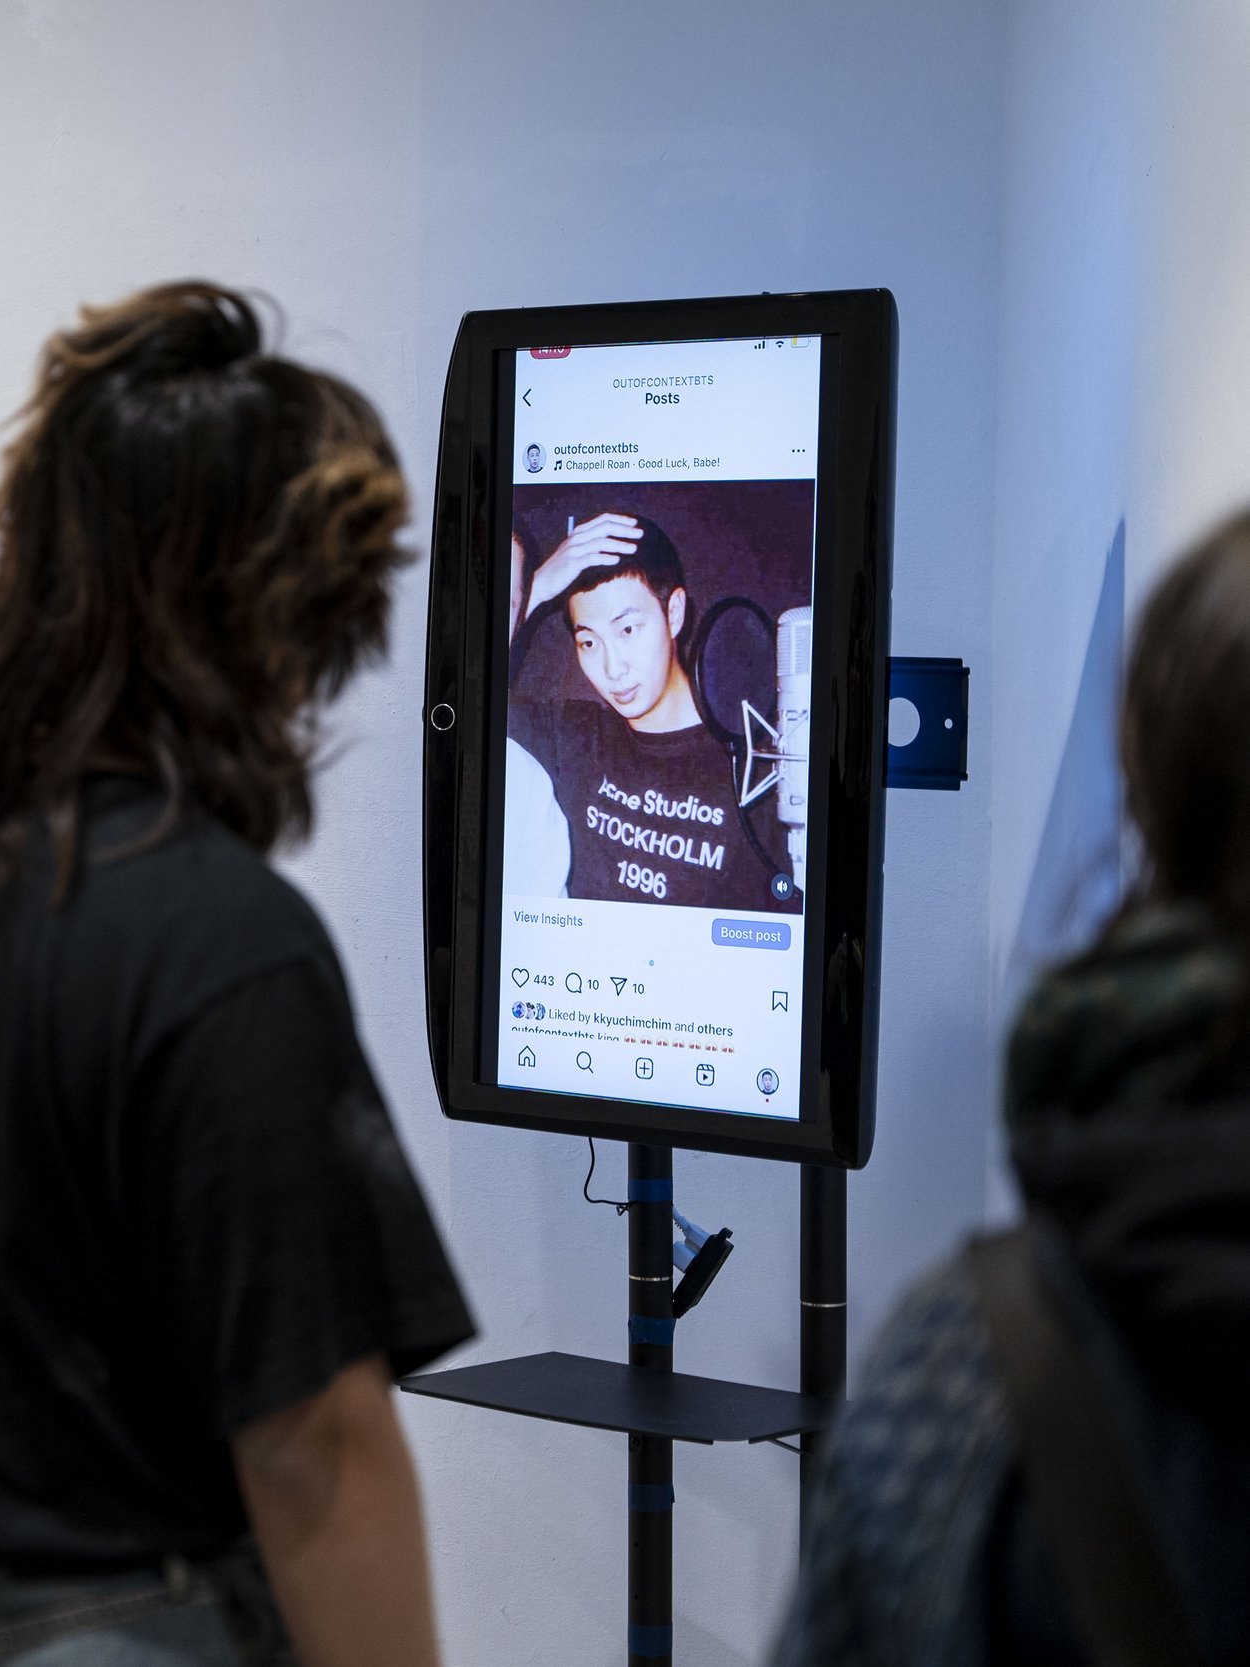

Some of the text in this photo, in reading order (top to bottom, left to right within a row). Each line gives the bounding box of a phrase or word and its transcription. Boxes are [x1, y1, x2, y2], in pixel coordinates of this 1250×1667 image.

[612, 375, 714, 388] OUTOFCONTEXTBTS
[645, 392, 680, 405] Posts
[553, 442, 639, 455] outofcontextbts
[565, 459, 605, 472] Chappell
[607, 459, 630, 469] Roan
[638, 458, 663, 469] Good
[665, 458, 690, 469] Luck,
[693, 457, 720, 468] Babe!
[643, 789, 725, 826] Studios
[587, 805, 725, 871] STOCKHOLM
[617, 860, 668, 899] 1996
[513, 911, 584, 928] View Insights
[720, 926, 782, 943] Boost post
[533, 974, 555, 987] 443
[587, 979, 600, 991] 10
[632, 983, 645, 995] 10
[548, 1008, 734, 1037] Liked by kkyuchimchim and others
